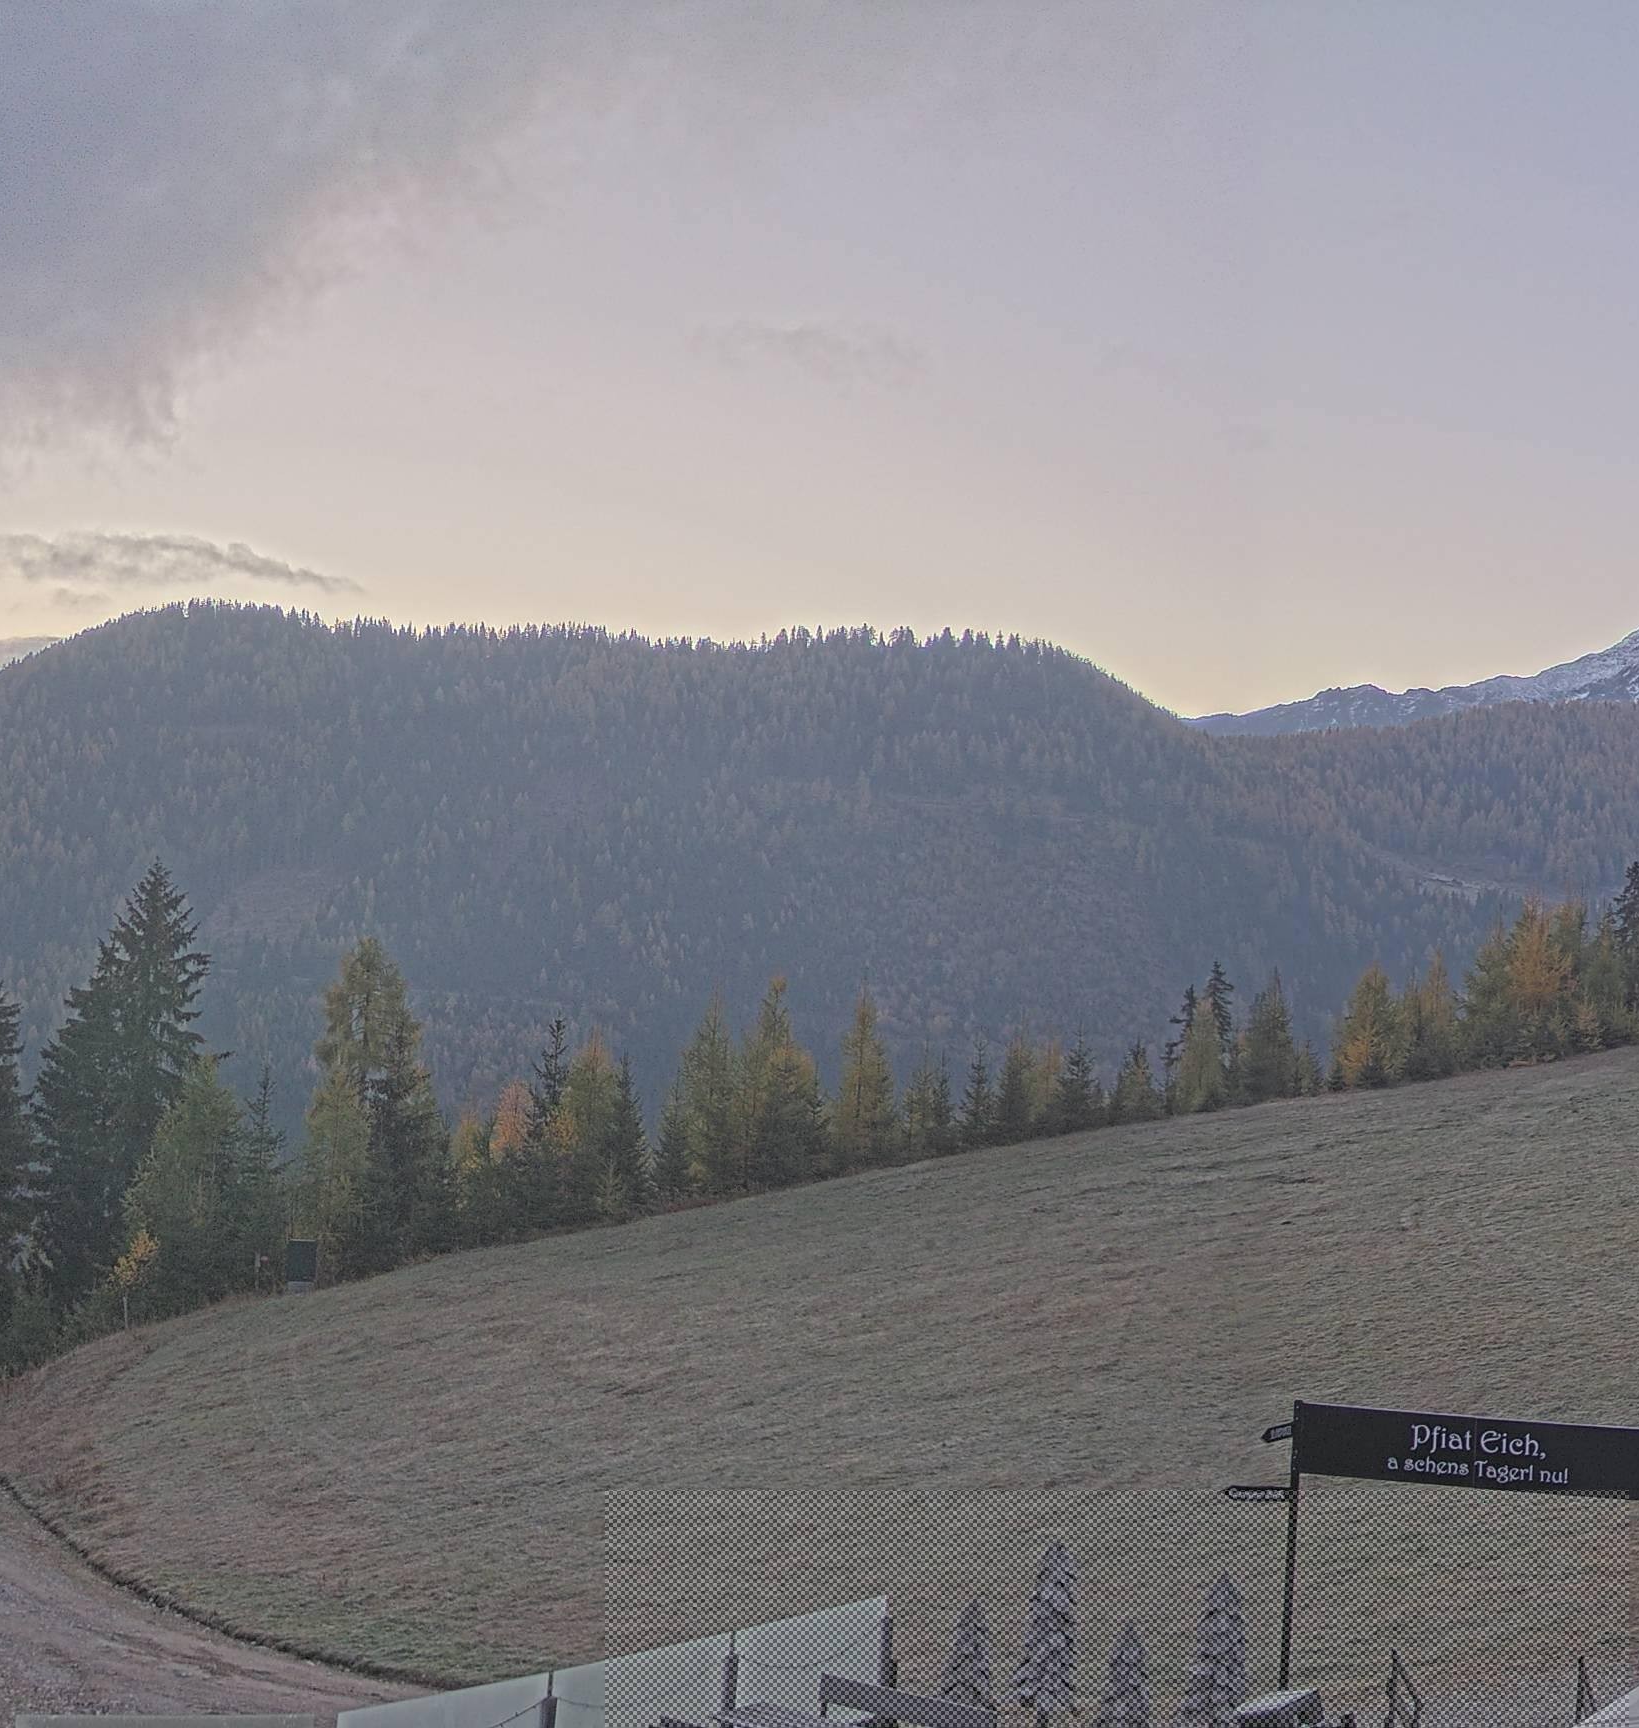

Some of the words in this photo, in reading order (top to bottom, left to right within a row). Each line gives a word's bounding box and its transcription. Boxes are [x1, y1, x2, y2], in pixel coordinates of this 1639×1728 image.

[1410, 1424, 1472, 1454] Pfiat
[1480, 1430, 1547, 1460] Eich,
[1387, 1456, 1399, 1470] a
[1403, 1456, 1470, 1476] schens
[1474, 1460, 1534, 1484] Tagerl
[1540, 1467, 1569, 1484] nu!
